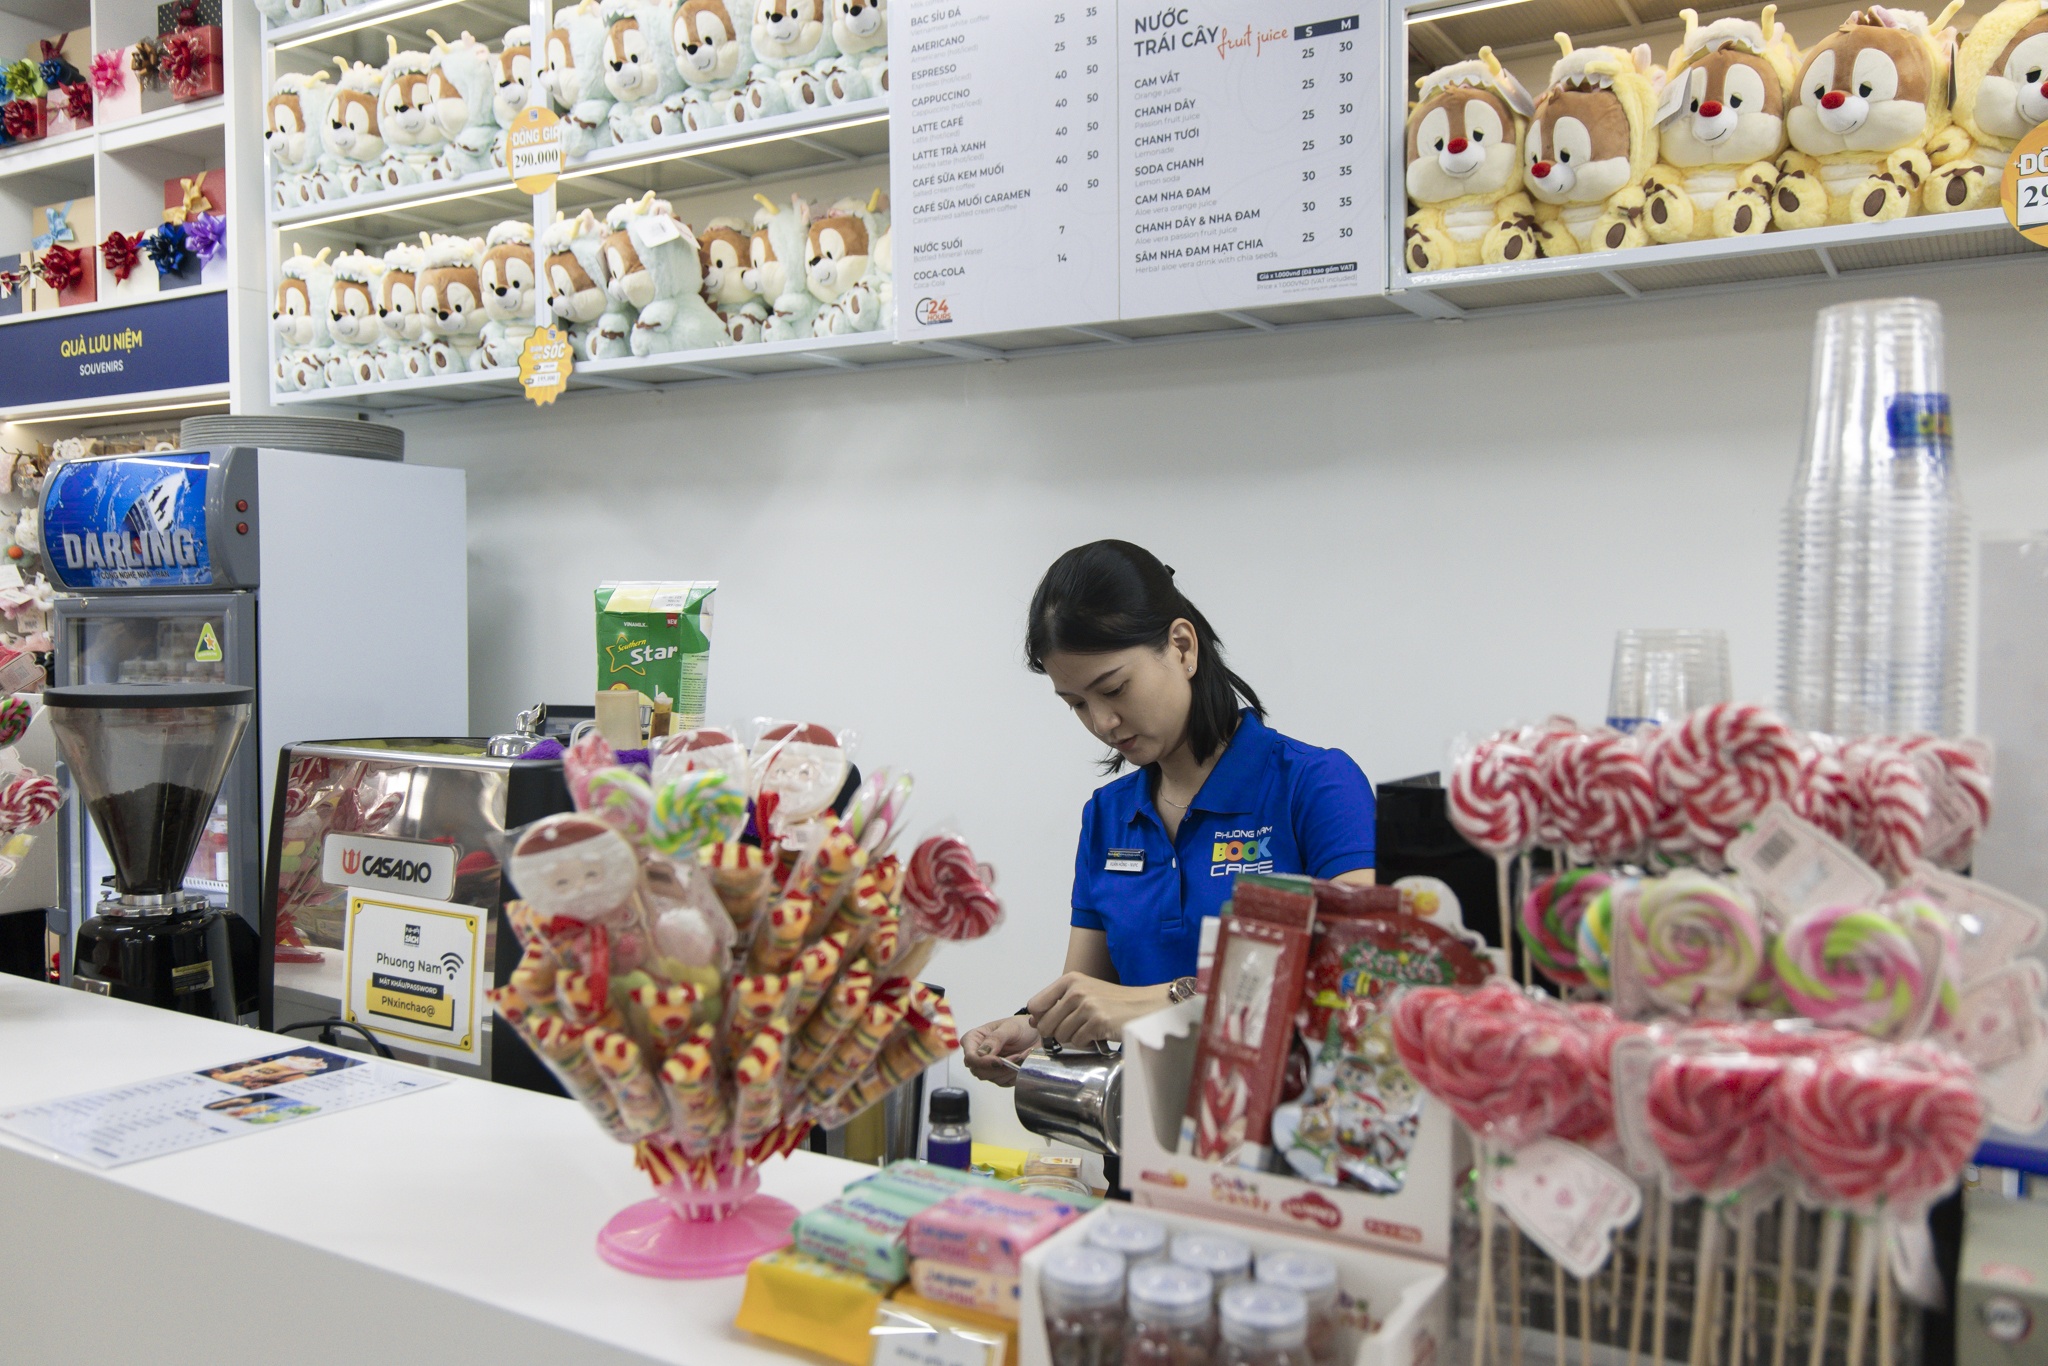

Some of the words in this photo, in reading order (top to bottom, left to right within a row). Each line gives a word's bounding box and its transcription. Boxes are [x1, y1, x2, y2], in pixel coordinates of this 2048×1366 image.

[948, 6, 961, 19] ĐÁ
[1054, 14, 1065, 24] 25
[1086, 7, 1097, 17] 35
[1135, 7, 1189, 34] NƯỚC
[1305, 27, 1313, 37] S
[1341, 19, 1352, 30] M
[911, 35, 965, 53] AMERICANO
[1055, 42, 1066, 52] 25
[1086, 36, 1097, 46] 35
[1134, 34, 1175, 57] TRÁI
[1182, 25, 1219, 48] CÂY
[1217, 24, 1252, 60] fruit
[1256, 27, 1289, 58] juice
[1302, 49, 1314, 59] 25
[1339, 41, 1353, 52] 30
[912, 64, 957, 80] ESPRESSO
[1055, 70, 1067, 80] 40
[1087, 64, 1098, 74] 50
[1134, 76, 1157, 89] CAM
[1302, 79, 1314, 90] 25
[1339, 72, 1353, 83] 30
[912, 89, 970, 107] CAPPUCCINO
[1055, 99, 1067, 108] 40
[1087, 93, 1098, 103] 50
[1135, 104, 1171, 119] CHANH
[1175, 97, 1196, 112] DÂY
[1302, 110, 1314, 120] 25
[1339, 103, 1353, 114] 30
[913, 122, 938, 134] LATTE
[941, 115, 963, 129] CAFÉ
[1056, 127, 1067, 136] 40
[1087, 122, 1099, 131] 50
[1135, 134, 1171, 147] CHANH
[1302, 141, 1314, 151] 25
[1339, 135, 1353, 145] 30
[515, 149, 559, 168] 290.000
[913, 149, 938, 161] LATTE
[941, 143, 958, 156] TRÀ
[961, 141, 986, 153] XANH
[1056, 155, 1068, 164] 40
[1087, 150, 1099, 160] 50
[913, 175, 935, 188] CAFÉ
[958, 170, 977, 180] KEM
[980, 163, 1004, 178] MUỐI
[1135, 164, 1164, 176] SODA
[1166, 158, 1204, 171] CHANH
[1302, 171, 1316, 181] 30
[1339, 166, 1352, 176] 35
[1056, 183, 1068, 193] 40
[1087, 179, 1099, 189] 50
[913, 202, 935, 214] CAFÉ
[958, 194, 982, 208] MUỐI
[984, 189, 1031, 204] CARAMEN
[1135, 193, 1158, 205] CAM
[1161, 189, 1183, 201] NHA
[1186, 186, 1211, 198] ĐAM
[1302, 202, 1316, 212] 30
[1339, 197, 1352, 207] 35
[1059, 225, 1065, 234] 7
[1135, 221, 1172, 234] CHANH
[1175, 214, 1196, 229] DÂY
[1199, 216, 1206, 226] &
[1209, 213, 1232, 224] NHA
[1235, 209, 1260, 221] ĐAM
[941, 237, 963, 251] SUỐI
[1302, 232, 1314, 243] 25
[1340, 228, 1353, 238] 30
[1057, 254, 1067, 263] 14
[1135, 251, 1157, 263] SÂM
[1160, 248, 1183, 260] NHA
[1186, 245, 1210, 257] ĐAM
[1237, 239, 1264, 251] CHIA
[914, 266, 965, 281] COCA-COLA
[929, 299, 949, 314] 24
[60, 333, 88, 358] QUÀ
[89, 333, 111, 354] LƯU
[113, 327, 143, 354] NIỆM
[79, 359, 124, 376] SOUVENIRS
[63, 527, 198, 570] DARLING
[617, 640, 646, 652] Southern
[630, 645, 678, 665] Star
[1214, 829, 1254, 840] PHUONG
[1256, 826, 1272, 838] NAM
[1212, 836, 1272, 862] BOOK
[362, 855, 432, 884] CASADIO
[1210, 860, 1274, 877] CAFE
[376, 952, 414, 972] Phuong
[418, 960, 442, 974] Nam
[382, 996, 436, 1018] PNxinchao@
